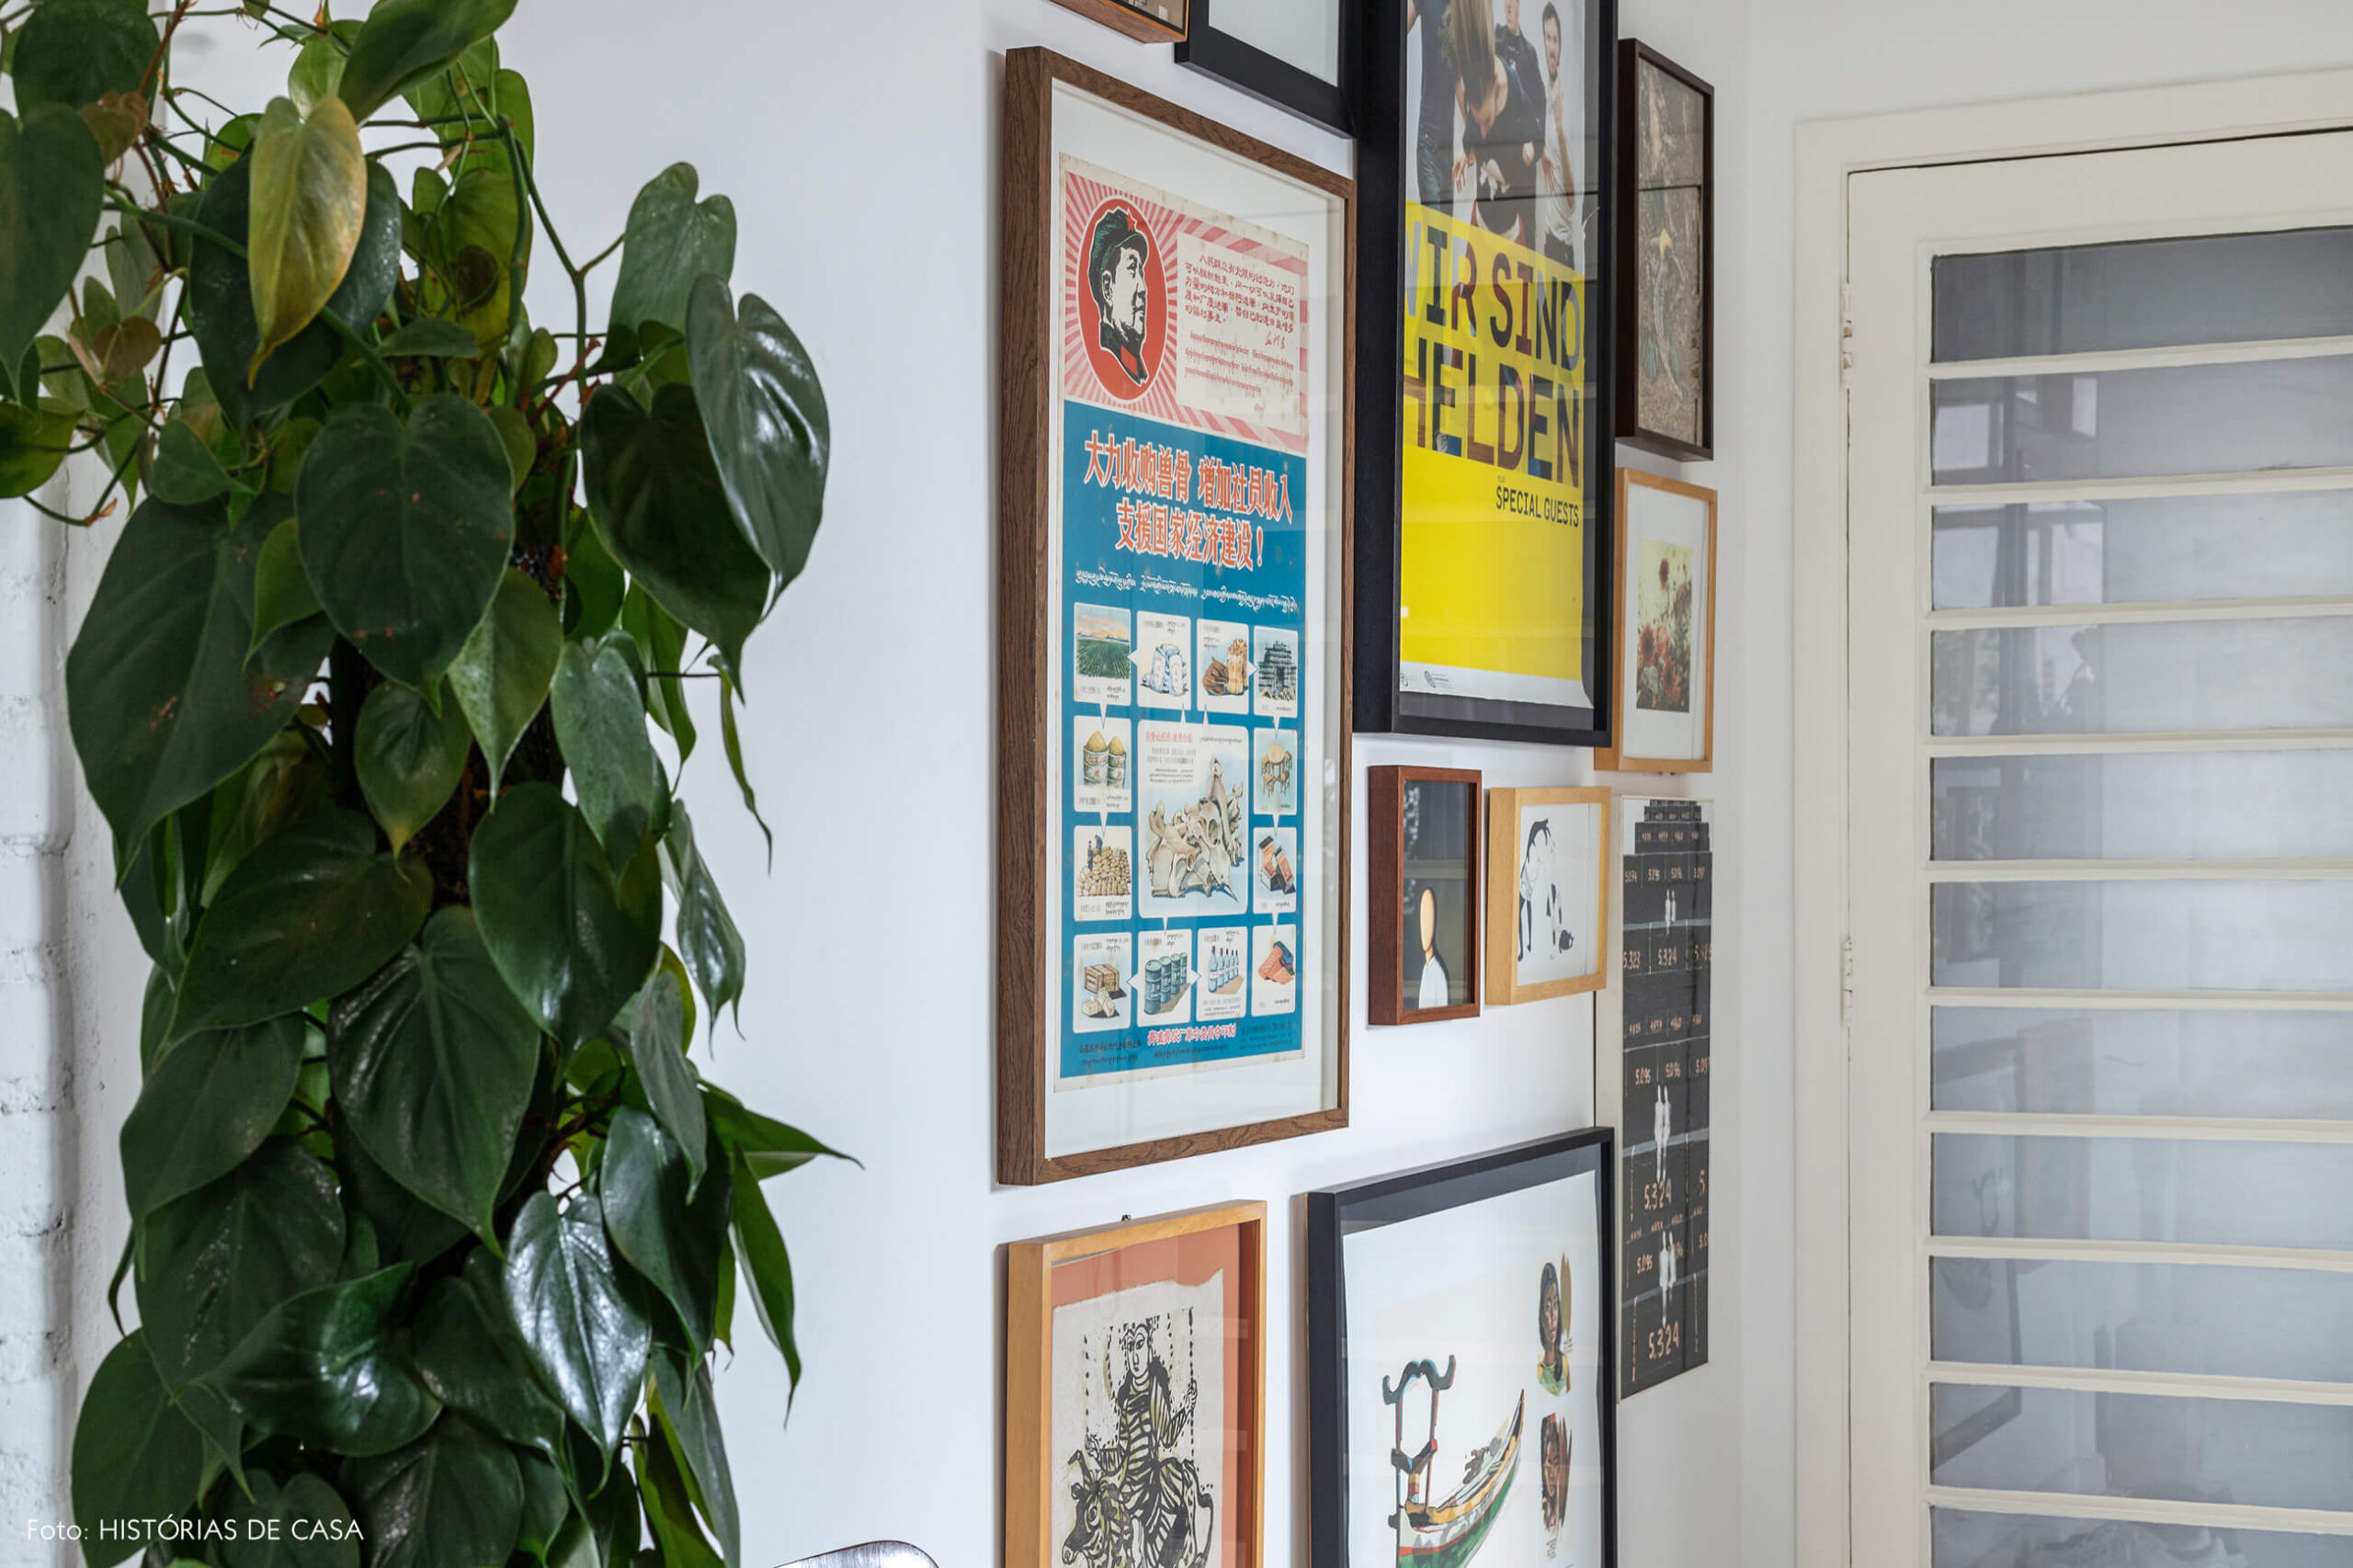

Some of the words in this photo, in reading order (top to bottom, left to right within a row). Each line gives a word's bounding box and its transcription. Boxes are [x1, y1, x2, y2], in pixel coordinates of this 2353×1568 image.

[1490, 252, 1582, 371] SIND
[1404, 336, 1579, 488] HELDEN
[1084, 429, 1192, 504] 大力收购兽骨
[1198, 455, 1293, 525] 增加社员收入
[1495, 485, 1541, 518] SPECIAL
[1544, 497, 1579, 528] GUESTS
[1657, 948, 1677, 966] 5.324
[1644, 1177, 1672, 1210] 5.324
[1648, 1321, 1679, 1360] 5.324
